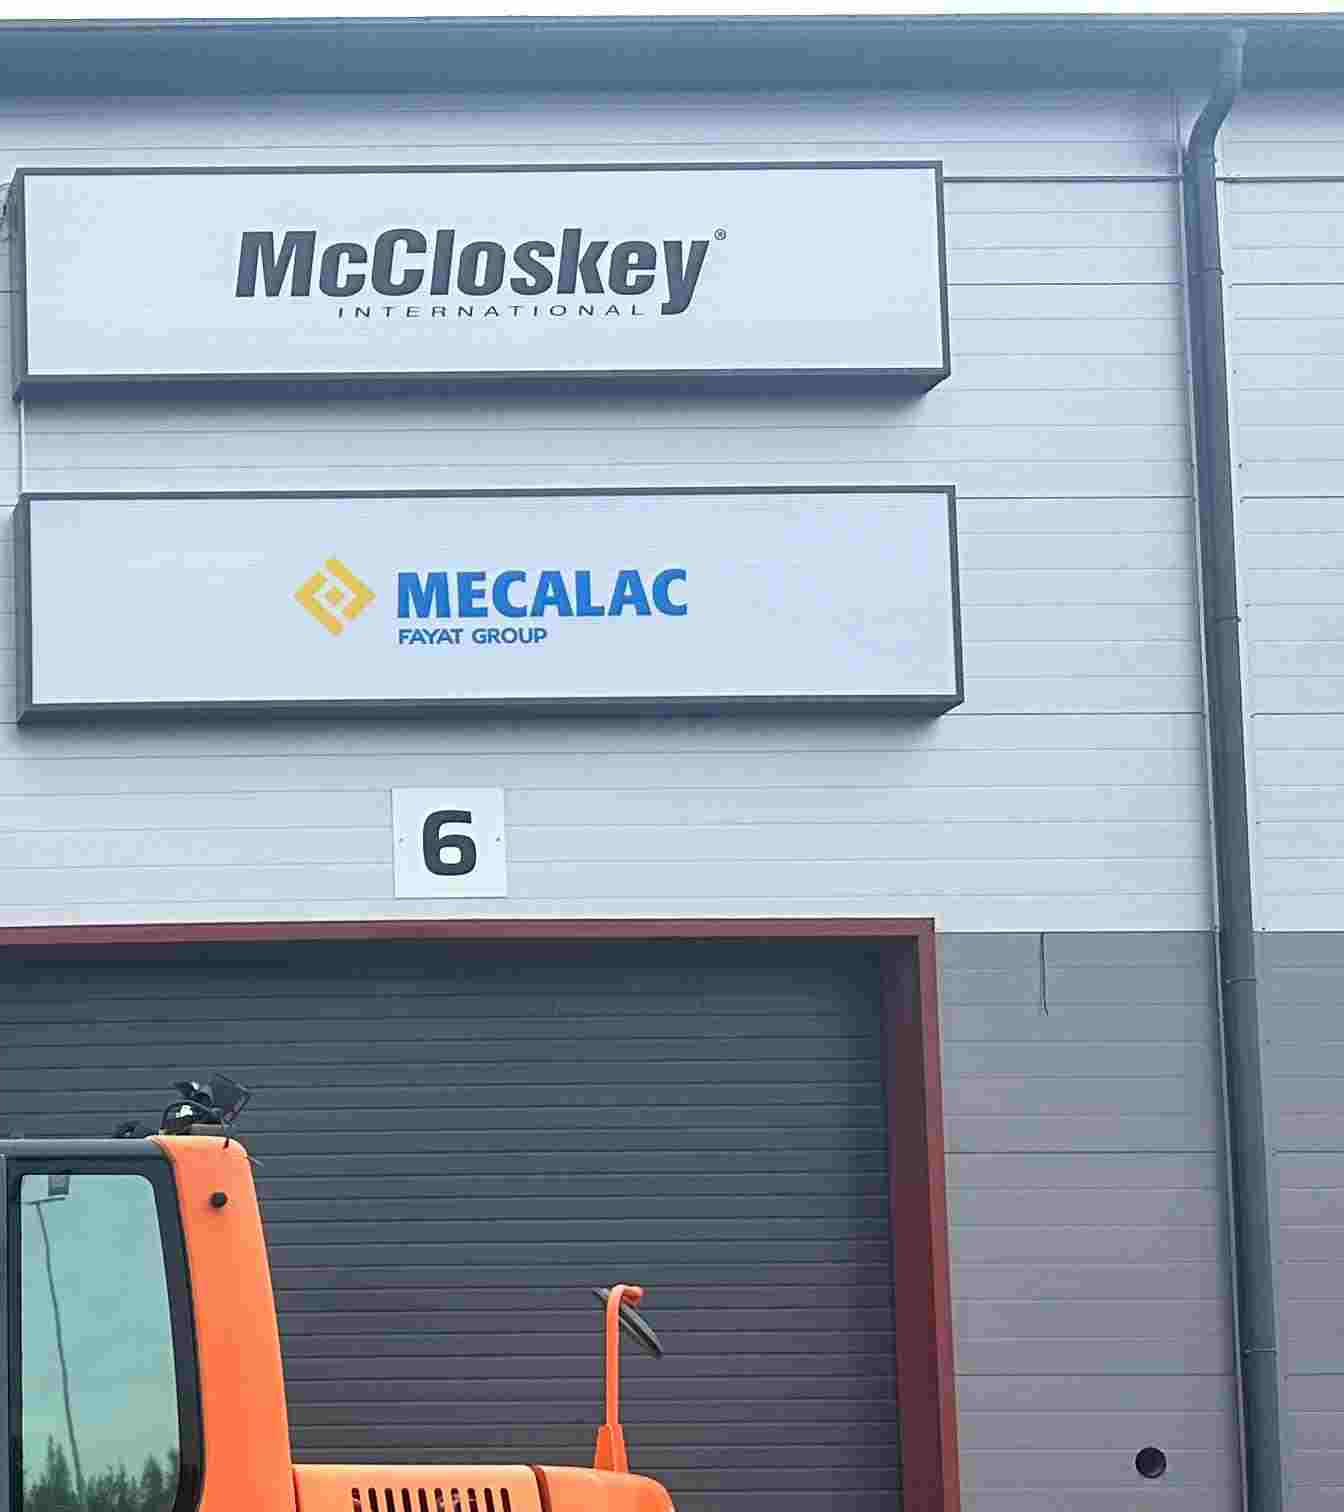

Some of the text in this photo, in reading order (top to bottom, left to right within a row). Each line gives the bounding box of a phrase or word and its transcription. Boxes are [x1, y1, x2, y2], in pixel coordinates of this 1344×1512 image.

[235, 228, 710, 316] McCloskey
[337, 303, 644, 318] INTERNATIONAL
[397, 568, 689, 618] MECALAC
[398, 627, 548, 645] FAYAT GROUP
[421, 809, 478, 876] 6
